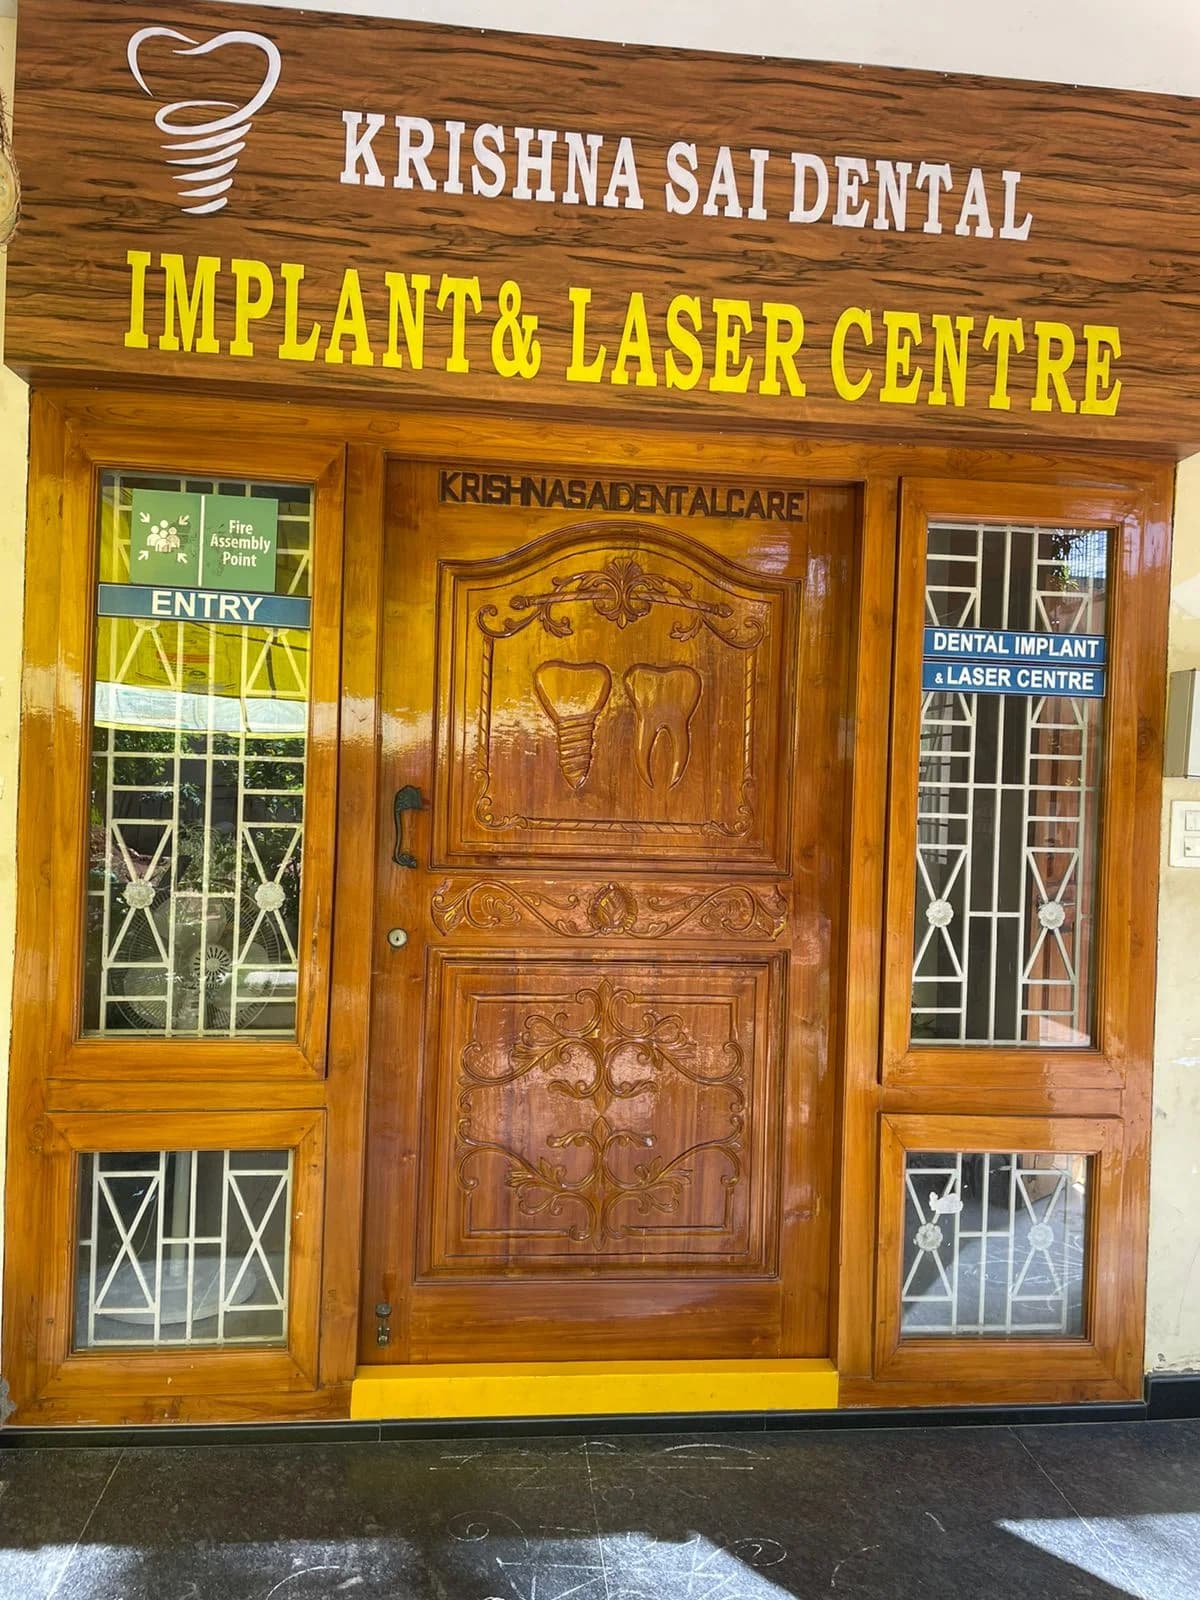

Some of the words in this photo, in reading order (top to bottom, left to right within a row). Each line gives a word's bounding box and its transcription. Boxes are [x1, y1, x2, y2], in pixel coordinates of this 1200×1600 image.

[340, 110, 644, 210] KRISHNA
[665, 141, 769, 220] SAI
[788, 152, 1033, 241] DENTAL
[566, 287, 807, 397] LASER
[831, 307, 1122, 416] CENTRE
[230, 520, 253, 534] Fire
[211, 534, 271, 553] Assembly
[223, 552, 257, 567] Point
[152, 591, 263, 620] ENTRY
[934, 632, 1009, 654] DENTAL
[1015, 636, 1099, 658] IMPLANT
[935, 673, 943, 684] &
[947, 667, 1011, 687] LASER
[1017, 670, 1094, 690] CENTRE
